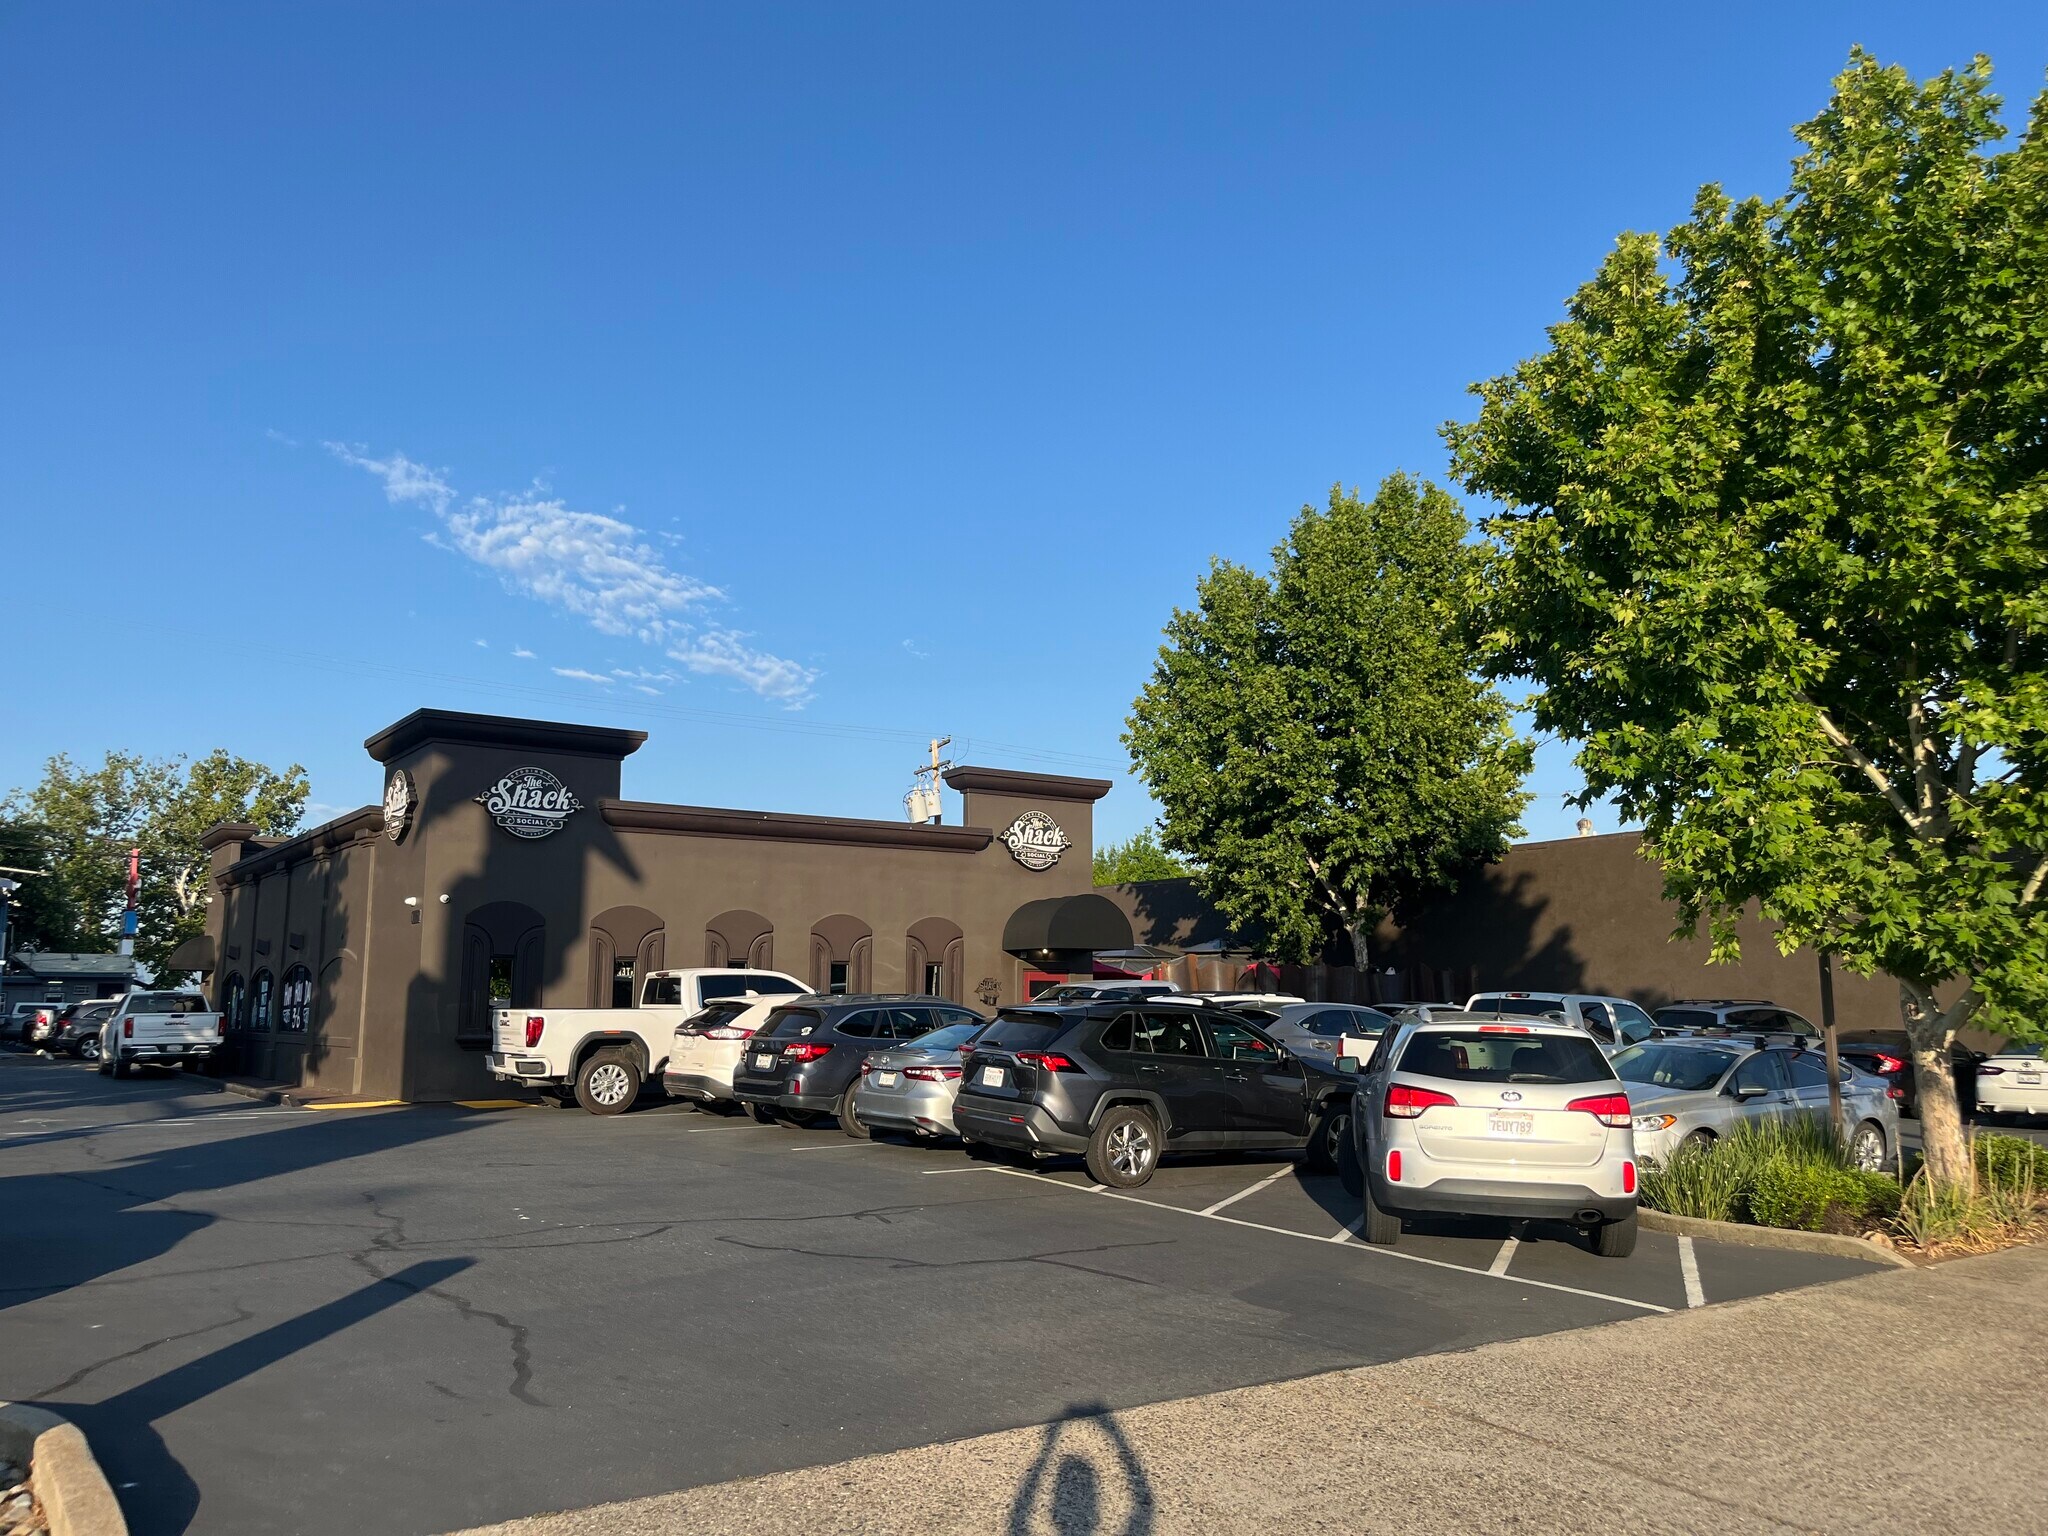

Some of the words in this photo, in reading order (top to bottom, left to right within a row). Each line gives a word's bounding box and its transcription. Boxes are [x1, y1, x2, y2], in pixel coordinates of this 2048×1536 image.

[522, 775, 544, 790] The
[487, 778, 575, 818] Shack
[516, 818, 544, 826] SOCIAL
[1008, 820, 1066, 852] Shack
[1490, 1120, 1532, 1133] 7EUY789
